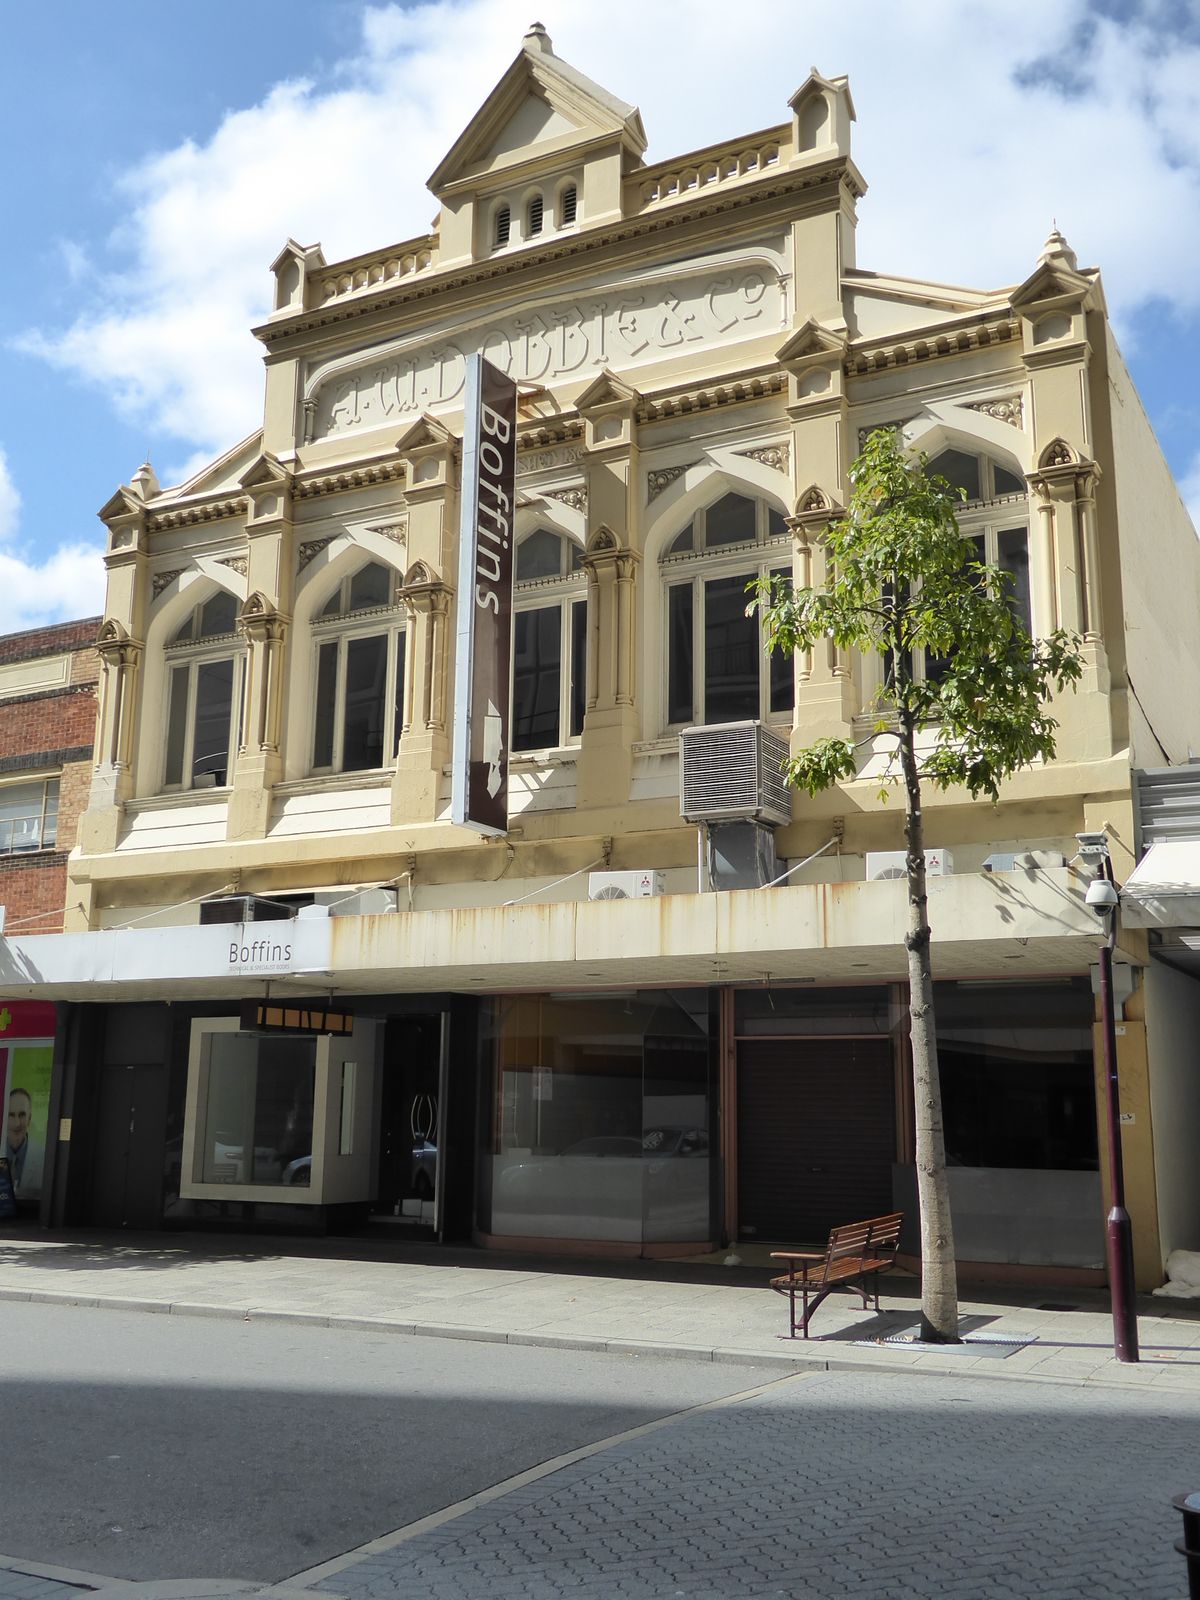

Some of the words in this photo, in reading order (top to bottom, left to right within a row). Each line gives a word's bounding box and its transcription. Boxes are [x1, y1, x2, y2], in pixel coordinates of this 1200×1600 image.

[652, 291, 704, 348] &
[476, 403, 510, 615] Boffins
[229, 940, 291, 963] Boffins
